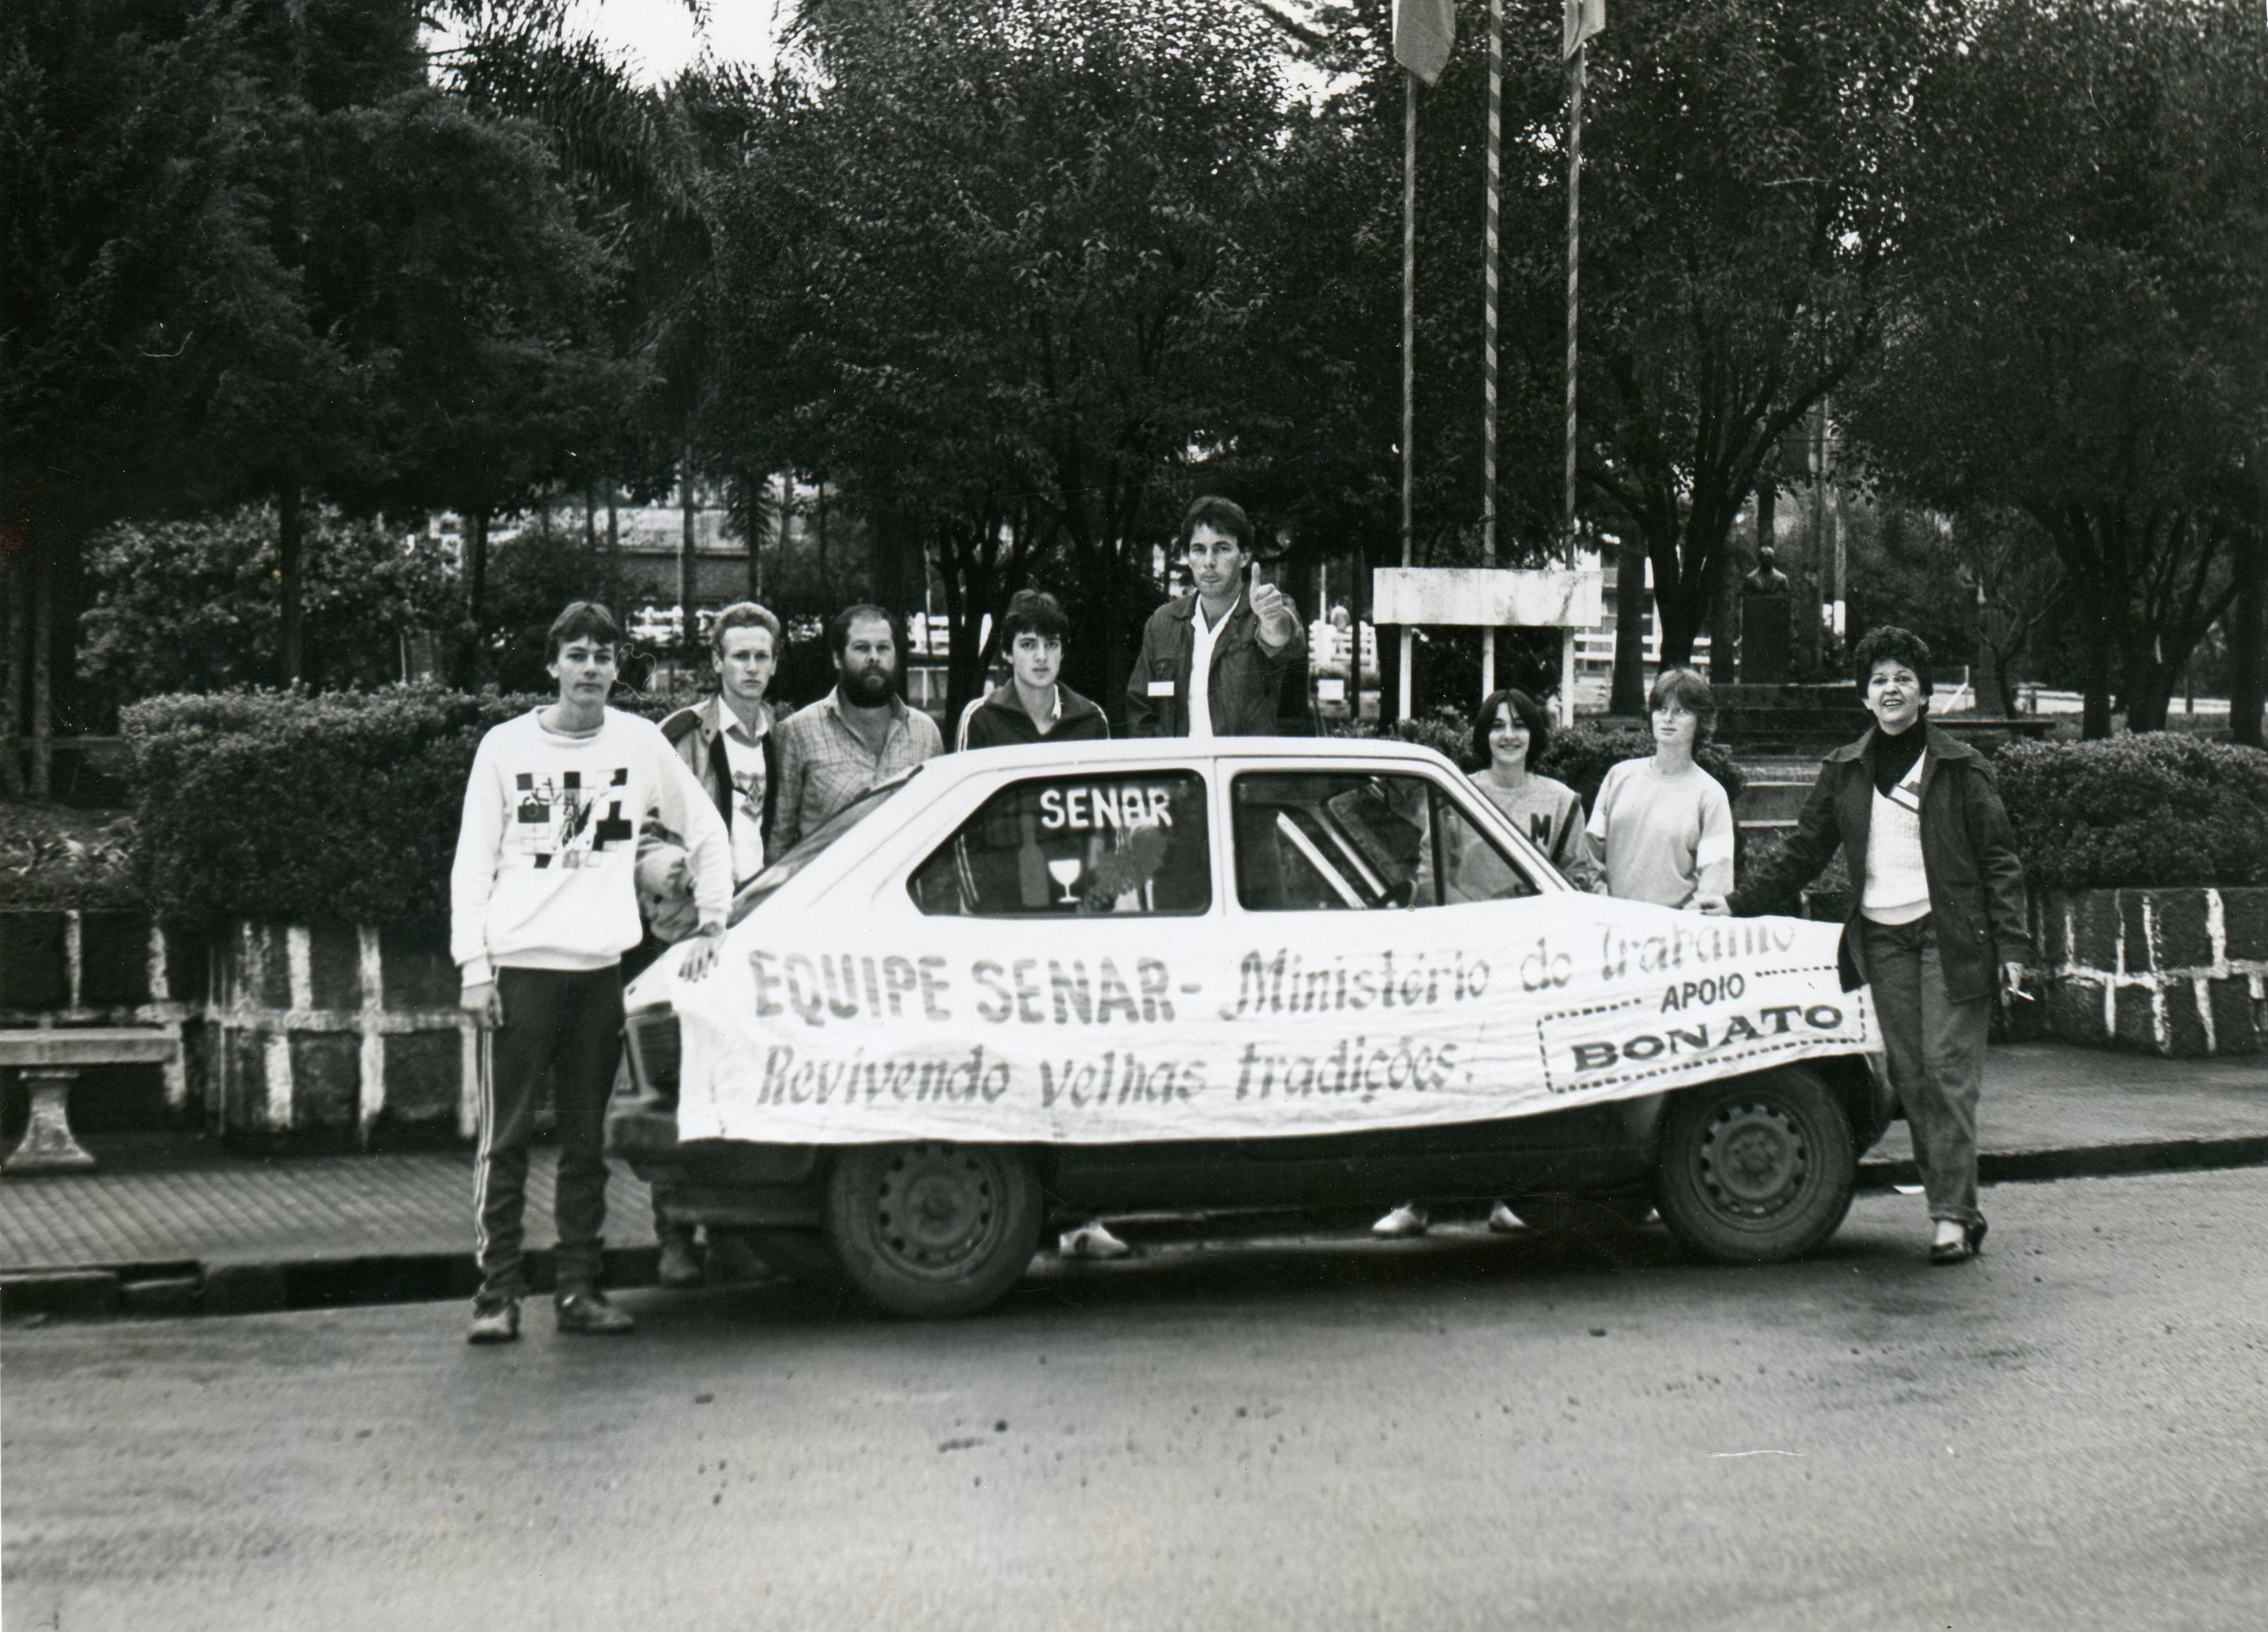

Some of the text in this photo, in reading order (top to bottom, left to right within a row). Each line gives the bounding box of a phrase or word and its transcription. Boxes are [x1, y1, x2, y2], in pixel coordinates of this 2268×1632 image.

[1039, 785, 1173, 829] SENAR
[1530, 812, 1552, 846] M
[749, 949, 952, 1028] EQUIPE
[1219, 947, 1491, 1021] Ministério
[1520, 937, 1572, 992] do
[1660, 972, 1745, 1013] APOIO
[1570, 1004, 1843, 1073] BONATO
[756, 1043, 1010, 1105] Revivendo
[1039, 1050, 1209, 1109] velhas
